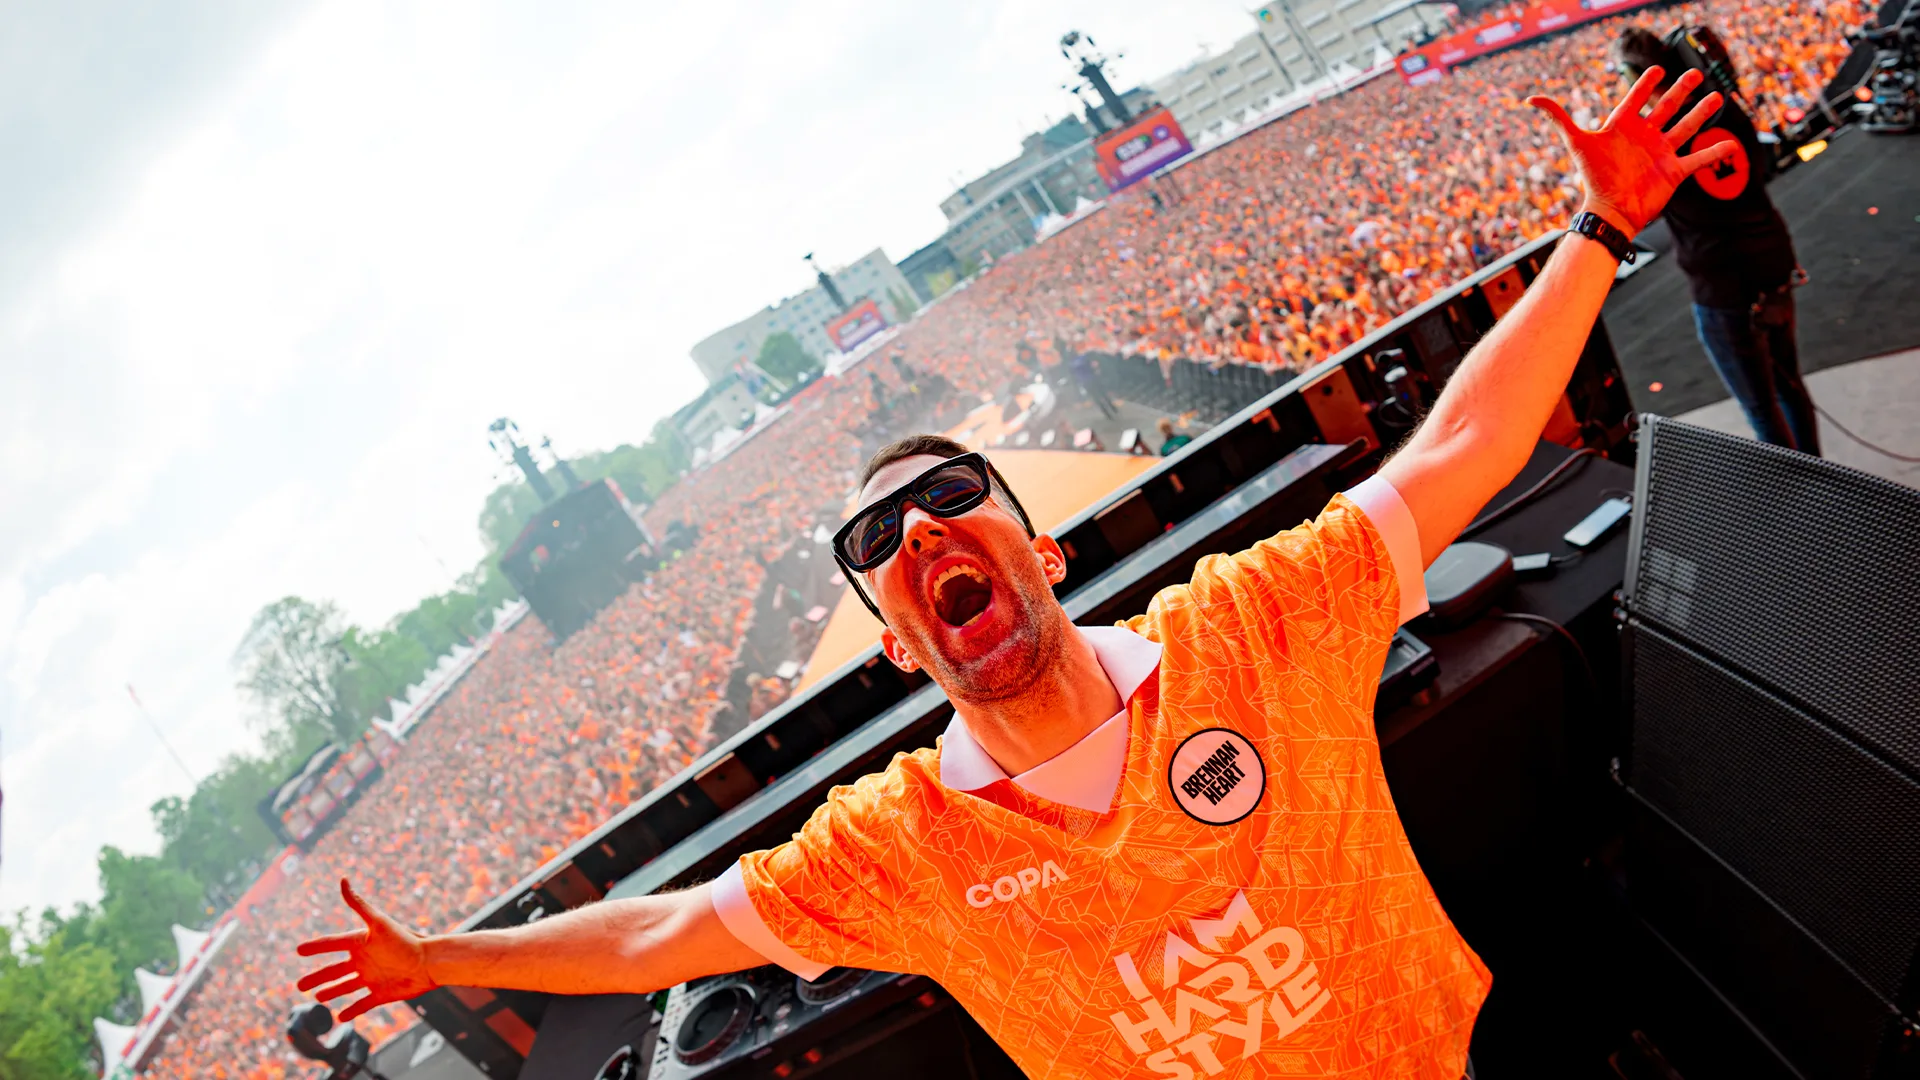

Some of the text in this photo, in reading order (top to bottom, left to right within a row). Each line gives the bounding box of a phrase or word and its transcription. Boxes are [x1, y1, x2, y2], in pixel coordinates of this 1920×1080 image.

[1181, 740, 1240, 799] BRENNAN
[1202, 761, 1246, 806] HEART
[965, 859, 1071, 909] COPA
[1113, 951, 1152, 1001] I
[1163, 888, 1263, 991] AM
[1109, 926, 1305, 1055] HARD
[1145, 961, 1332, 1080] STYLE
